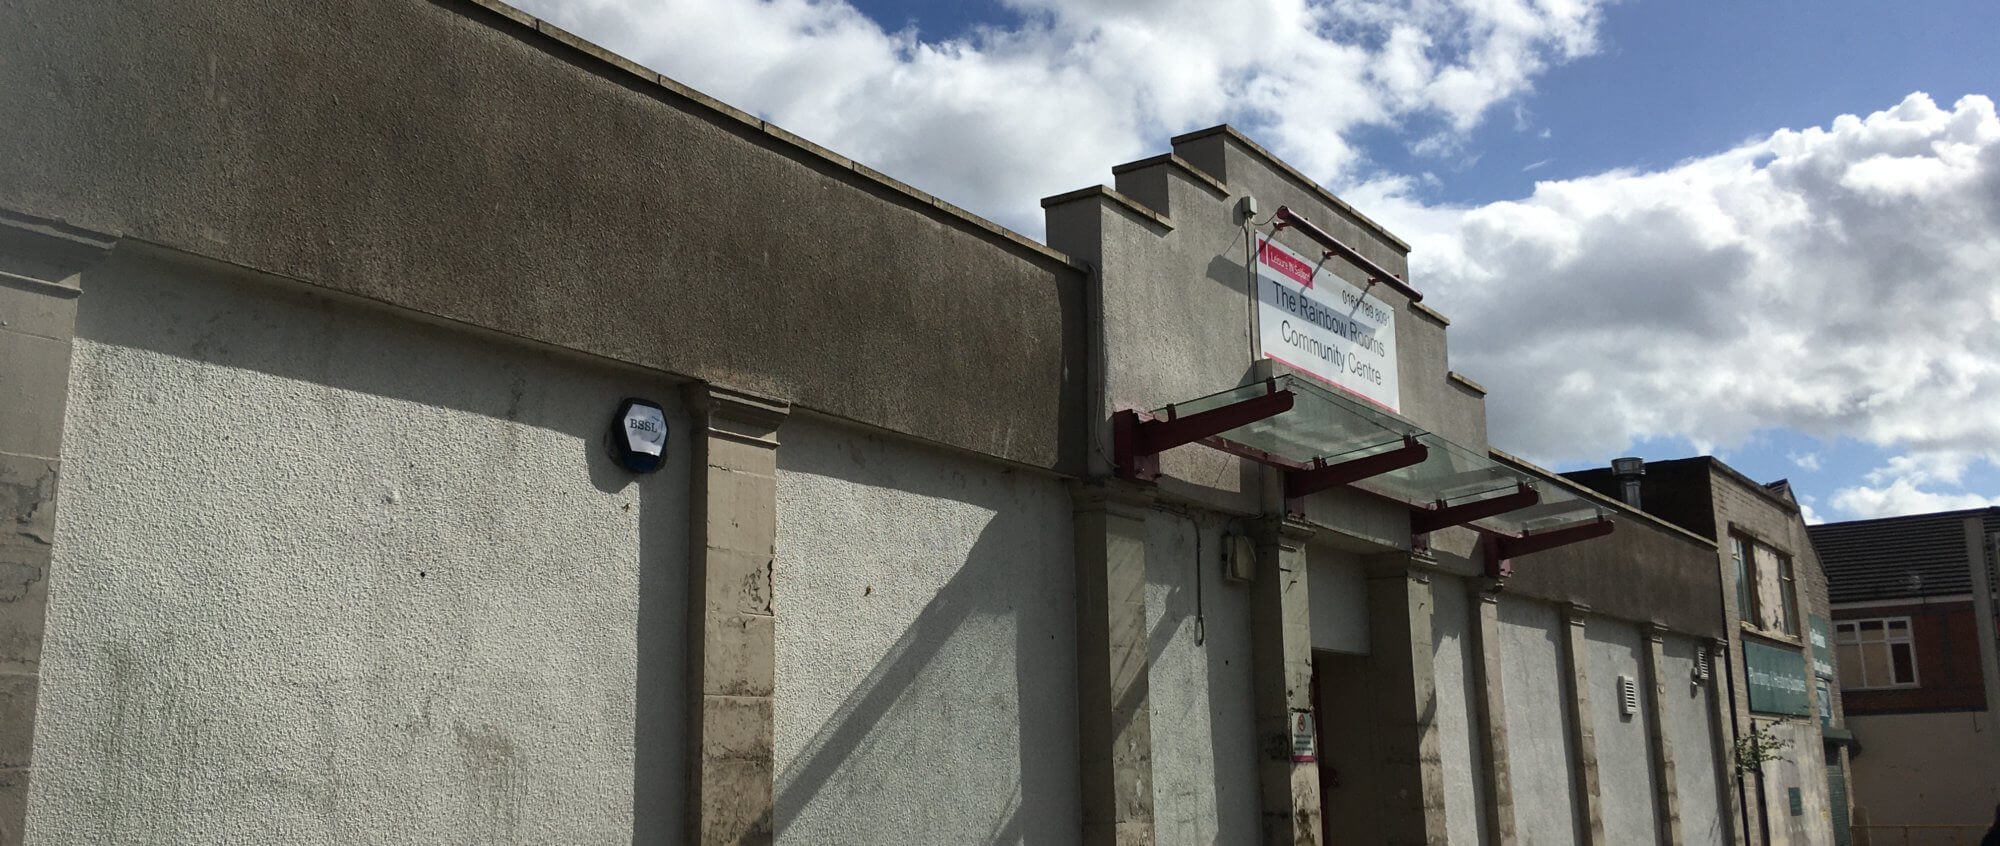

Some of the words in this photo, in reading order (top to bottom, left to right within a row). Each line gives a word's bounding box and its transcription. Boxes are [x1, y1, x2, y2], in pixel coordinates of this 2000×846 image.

[1273, 281, 1296, 312] The
[1300, 295, 1347, 338] Rainbow
[1350, 321, 1385, 358] Rooms
[1360, 300, 1374, 319] 789
[1281, 320, 1345, 373] Community
[1348, 352, 1382, 386] Centre
[630, 418, 658, 433] BSSL
